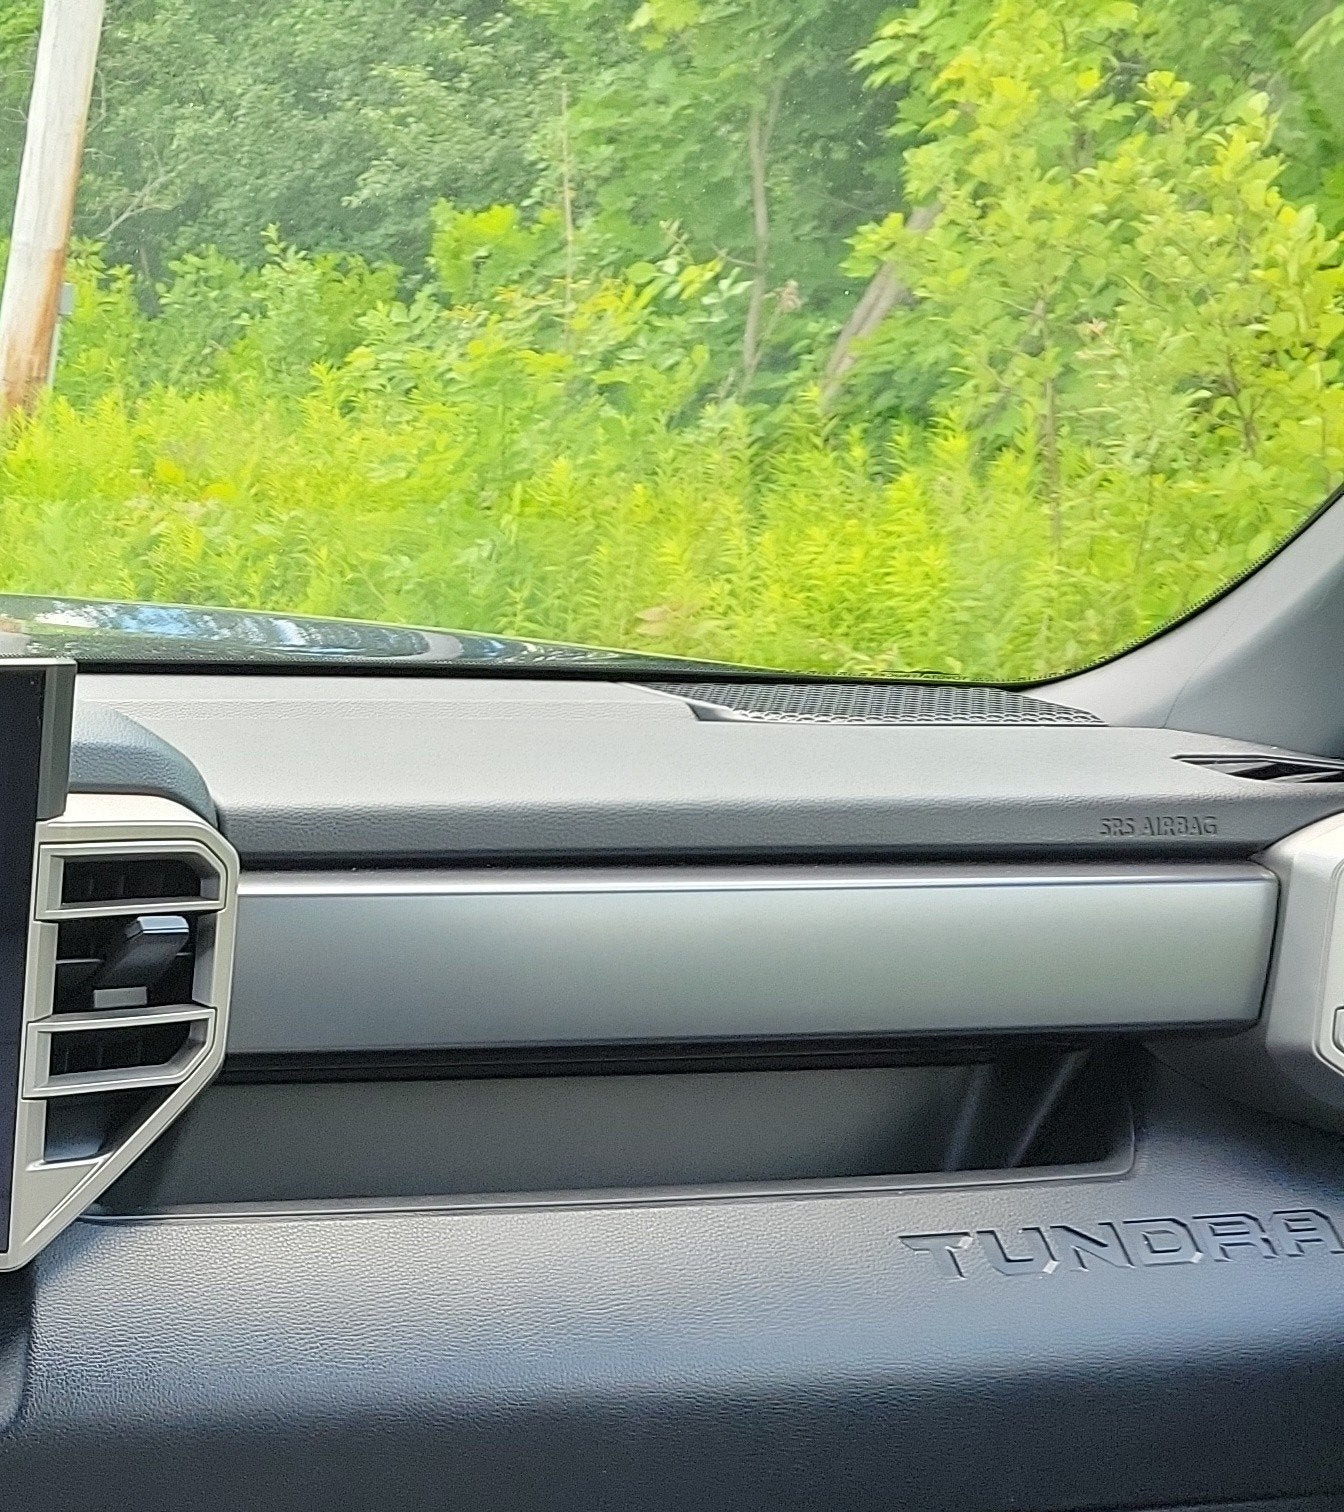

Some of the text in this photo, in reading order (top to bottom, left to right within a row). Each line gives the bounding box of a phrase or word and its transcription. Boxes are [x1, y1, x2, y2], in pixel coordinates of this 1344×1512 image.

[1100, 816, 1218, 836] SRS AIRBAG
[898, 1209, 1344, 1280] TUNDRA
